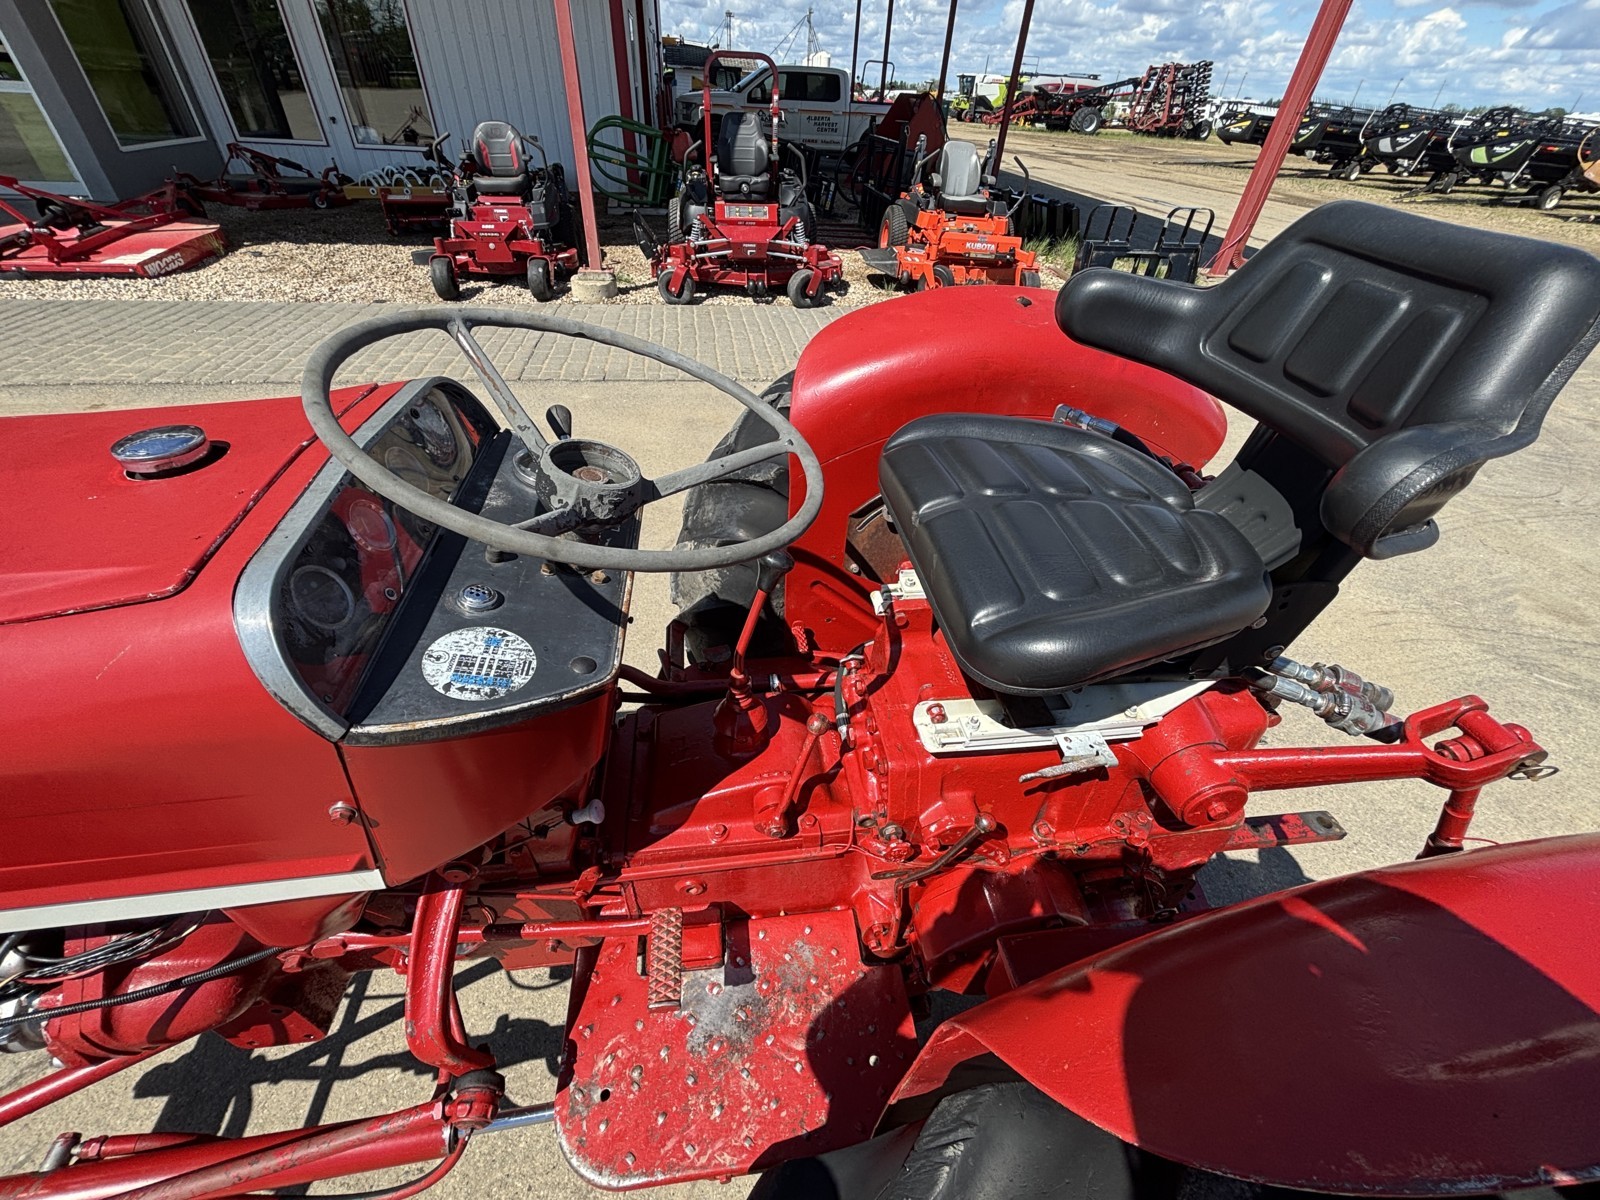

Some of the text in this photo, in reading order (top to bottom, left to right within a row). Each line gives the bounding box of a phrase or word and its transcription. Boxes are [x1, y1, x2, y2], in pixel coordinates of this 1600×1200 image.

[806, 115, 831, 123] ALBERTA
[966, 242, 995, 251] KUBOTA
[144, 252, 184, 276] WOODS
